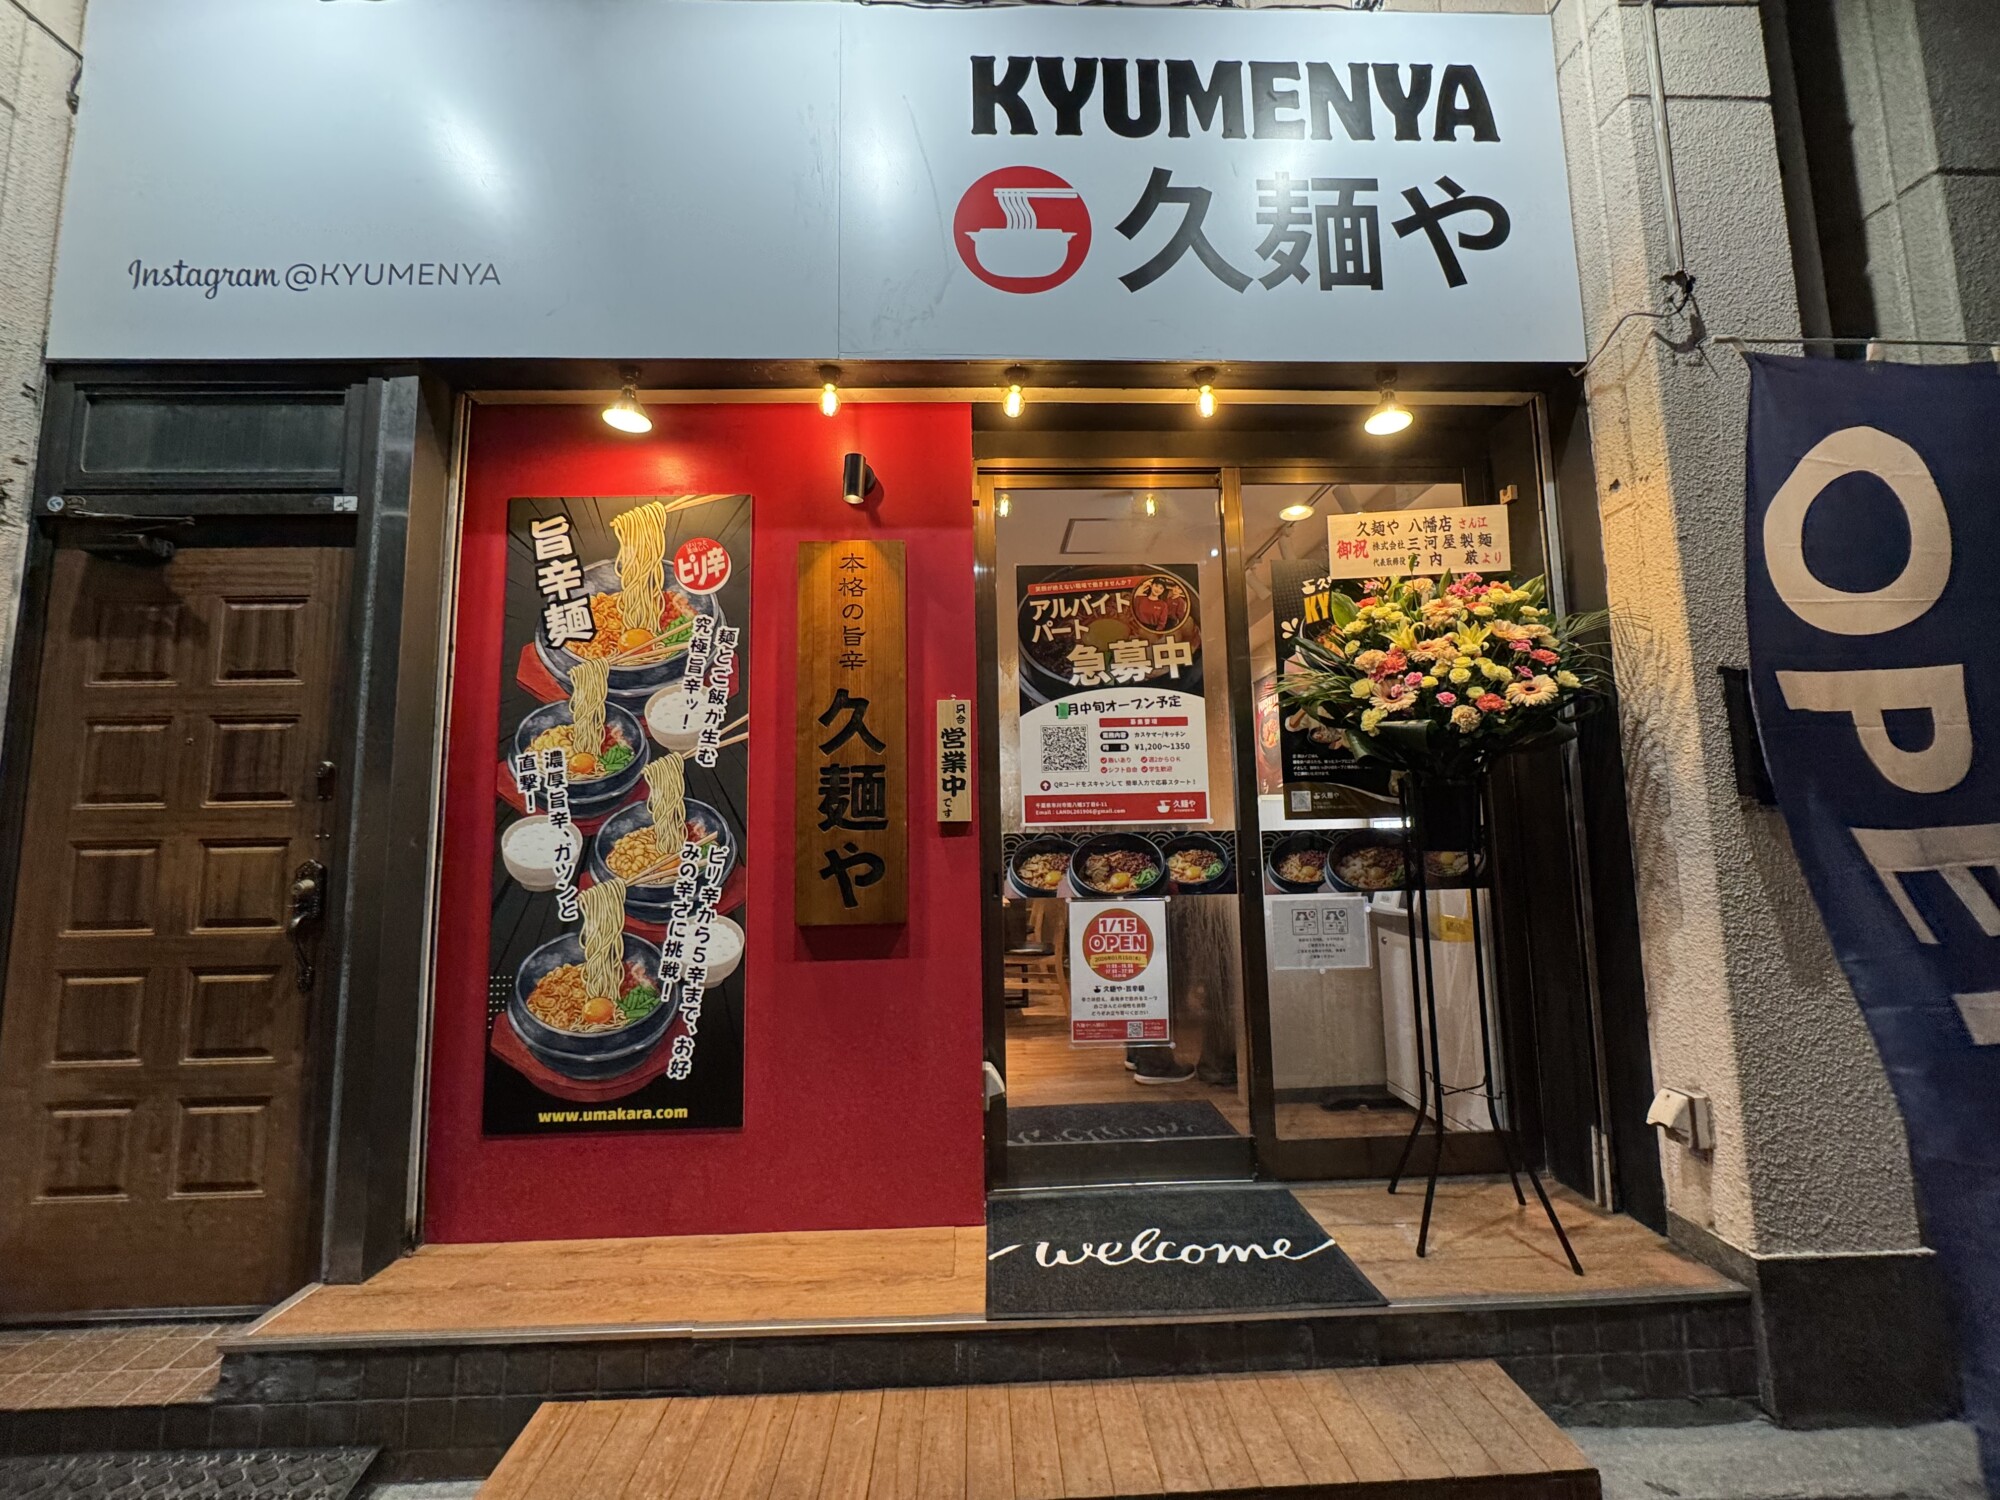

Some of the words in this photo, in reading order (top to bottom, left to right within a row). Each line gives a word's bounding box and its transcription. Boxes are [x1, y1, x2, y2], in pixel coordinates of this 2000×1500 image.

[970, 56, 1501, 142] KYUMENYA
[1116, 167, 1511, 294] 久麺や
[128, 259, 280, 300] Instagram
[285, 263, 502, 291] @KYUMENYA
[1356, 519, 1399, 537] 久麺や
[1408, 515, 1452, 533] 八幡店
[677, 546, 726, 586] ピリ辛
[1336, 539, 1369, 560] 御祝
[531, 515, 595, 650] 旨辛麺
[838, 552, 878, 670] 本格の旨辛
[1029, 593, 1130, 621] アルバイト
[1032, 619, 1089, 643] パート
[1066, 635, 1193, 686] 急募中
[697, 627, 739, 767] 麺とご飯が生む
[1055, 695, 1182, 716] 1月中旬オープン予定
[1762, 424, 2000, 1050] OPE
[516, 752, 540, 813] 直撃！
[817, 688, 898, 911] 久麺や
[544, 748, 579, 921] 濃厚旨辛、ガツンと
[661, 841, 701, 1002] みの辛さに挑戦！
[1089, 935, 1147, 953] OPEN
[1100, 919, 1136, 933] 1/15
[538, 1107, 688, 1123] www.umakara.com
[989, 1228, 1336, 1267] welcome
